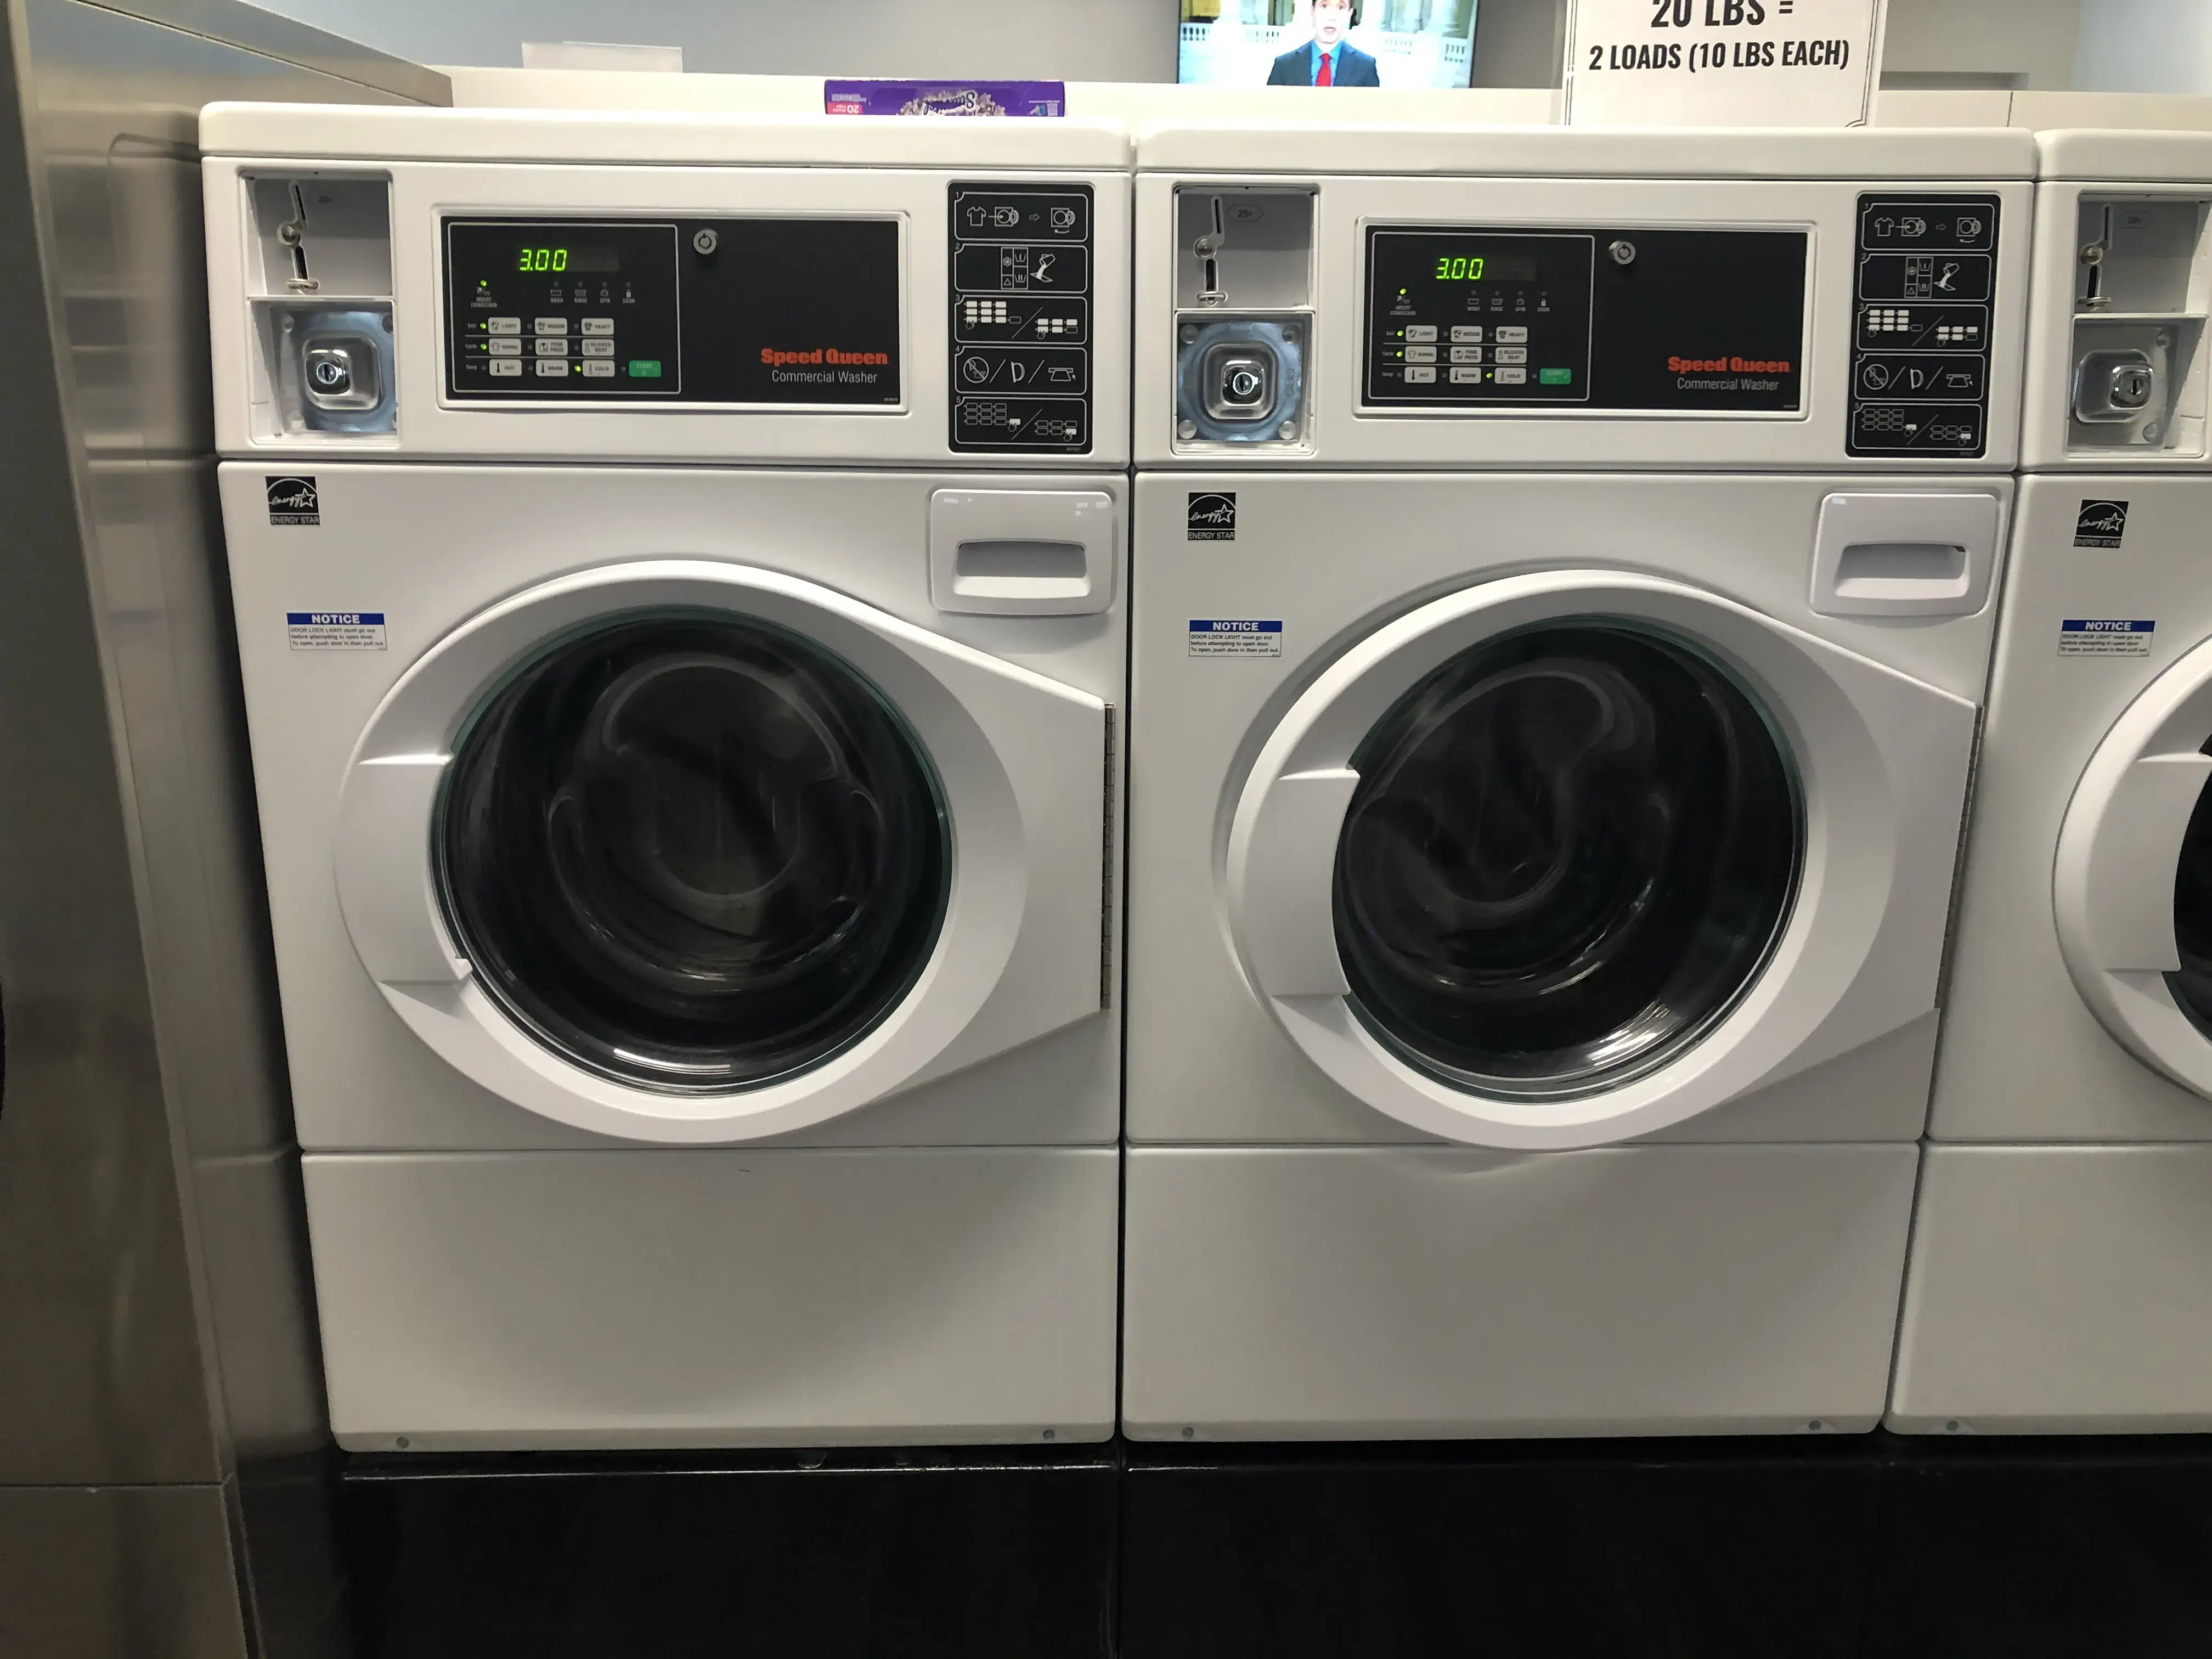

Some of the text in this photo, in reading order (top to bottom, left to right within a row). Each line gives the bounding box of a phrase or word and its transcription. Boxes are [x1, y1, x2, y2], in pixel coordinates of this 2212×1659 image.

[1651, 0, 1691, 27] 20
[1705, 0, 1765, 26] LBS
[1589, 40, 1849, 73] 2 LOADS (10 LBS EACH)
[847, 104, 859, 114] 20
[520, 249, 567, 271] 3.00
[1436, 258, 1483, 279] 3.00
[760, 348, 888, 366] Speed Queen
[1668, 356, 1790, 374] Speed Queen
[772, 369, 877, 383] Commercial Washer
[1677, 377, 1779, 391] Commercial Washer
[1188, 512, 1220, 523] energy
[311, 614, 360, 624] NOTICE
[1212, 622, 1259, 631] NOTICE
[2085, 622, 2132, 631] NOTICE
